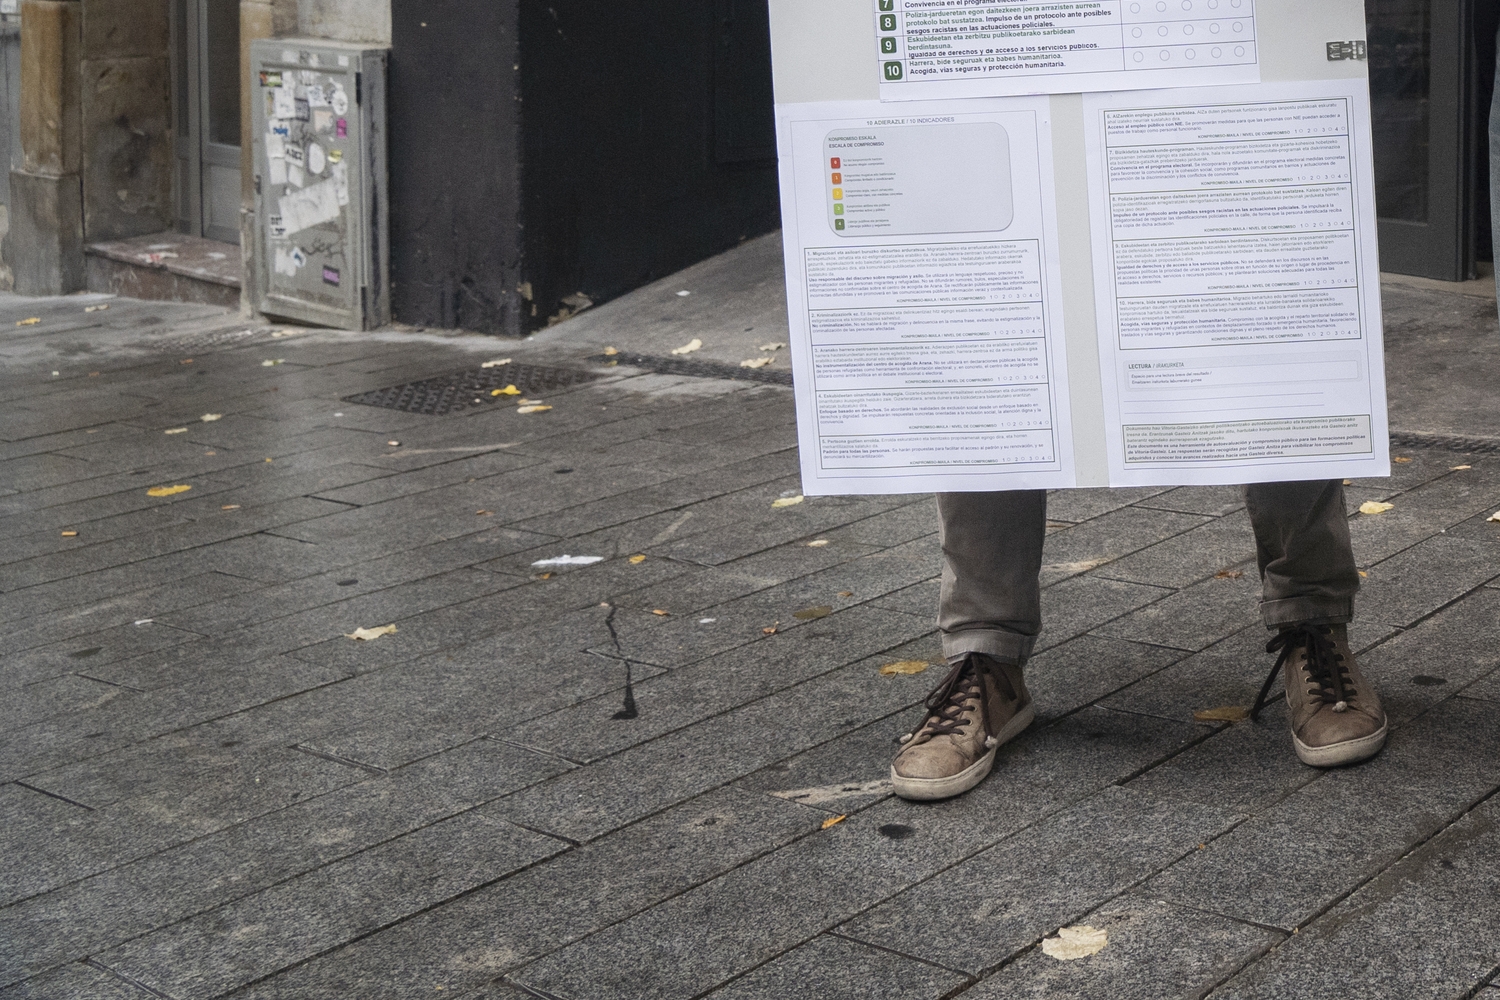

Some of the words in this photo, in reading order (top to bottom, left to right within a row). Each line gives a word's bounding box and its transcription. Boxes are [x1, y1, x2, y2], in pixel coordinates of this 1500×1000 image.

[882, 0, 889, 8] 7
[884, 18, 892, 27] 8
[885, 41, 892, 51] 9
[887, 65, 900, 76] 10
